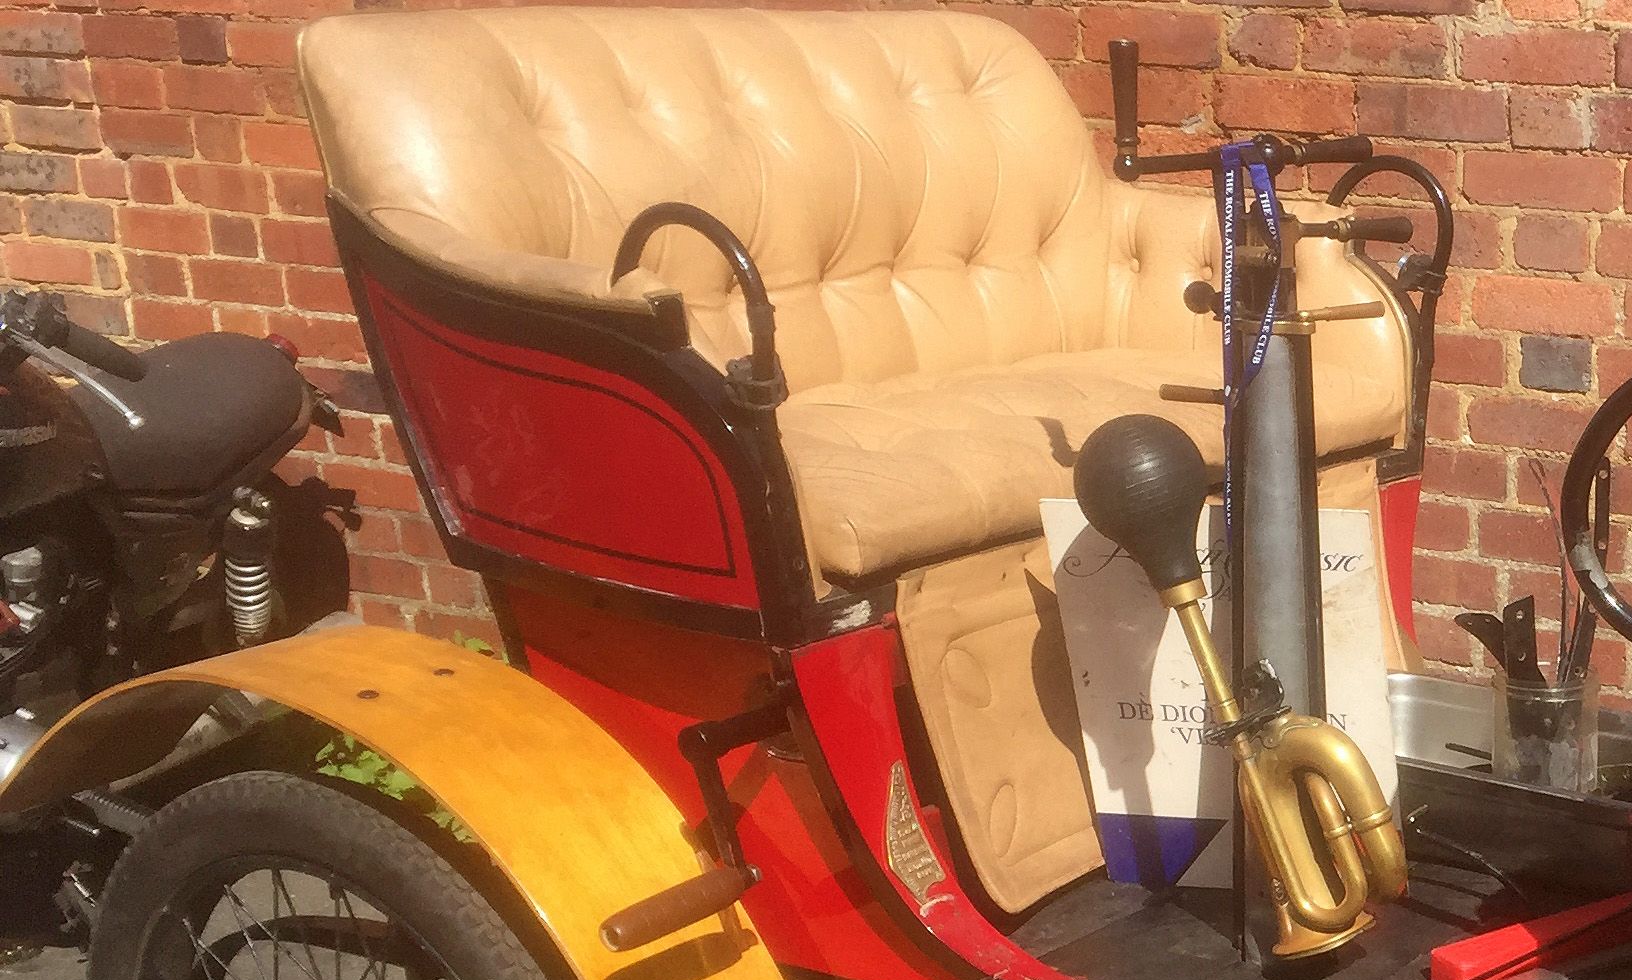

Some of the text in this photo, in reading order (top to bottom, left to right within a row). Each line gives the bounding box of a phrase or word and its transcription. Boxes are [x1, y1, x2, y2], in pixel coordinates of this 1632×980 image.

[1259, 190, 1273, 216] THE
[1223, 169, 1235, 346] THE ROYAL AUTOMOBILE CLUB
[1252, 334, 1267, 364] CLUB
